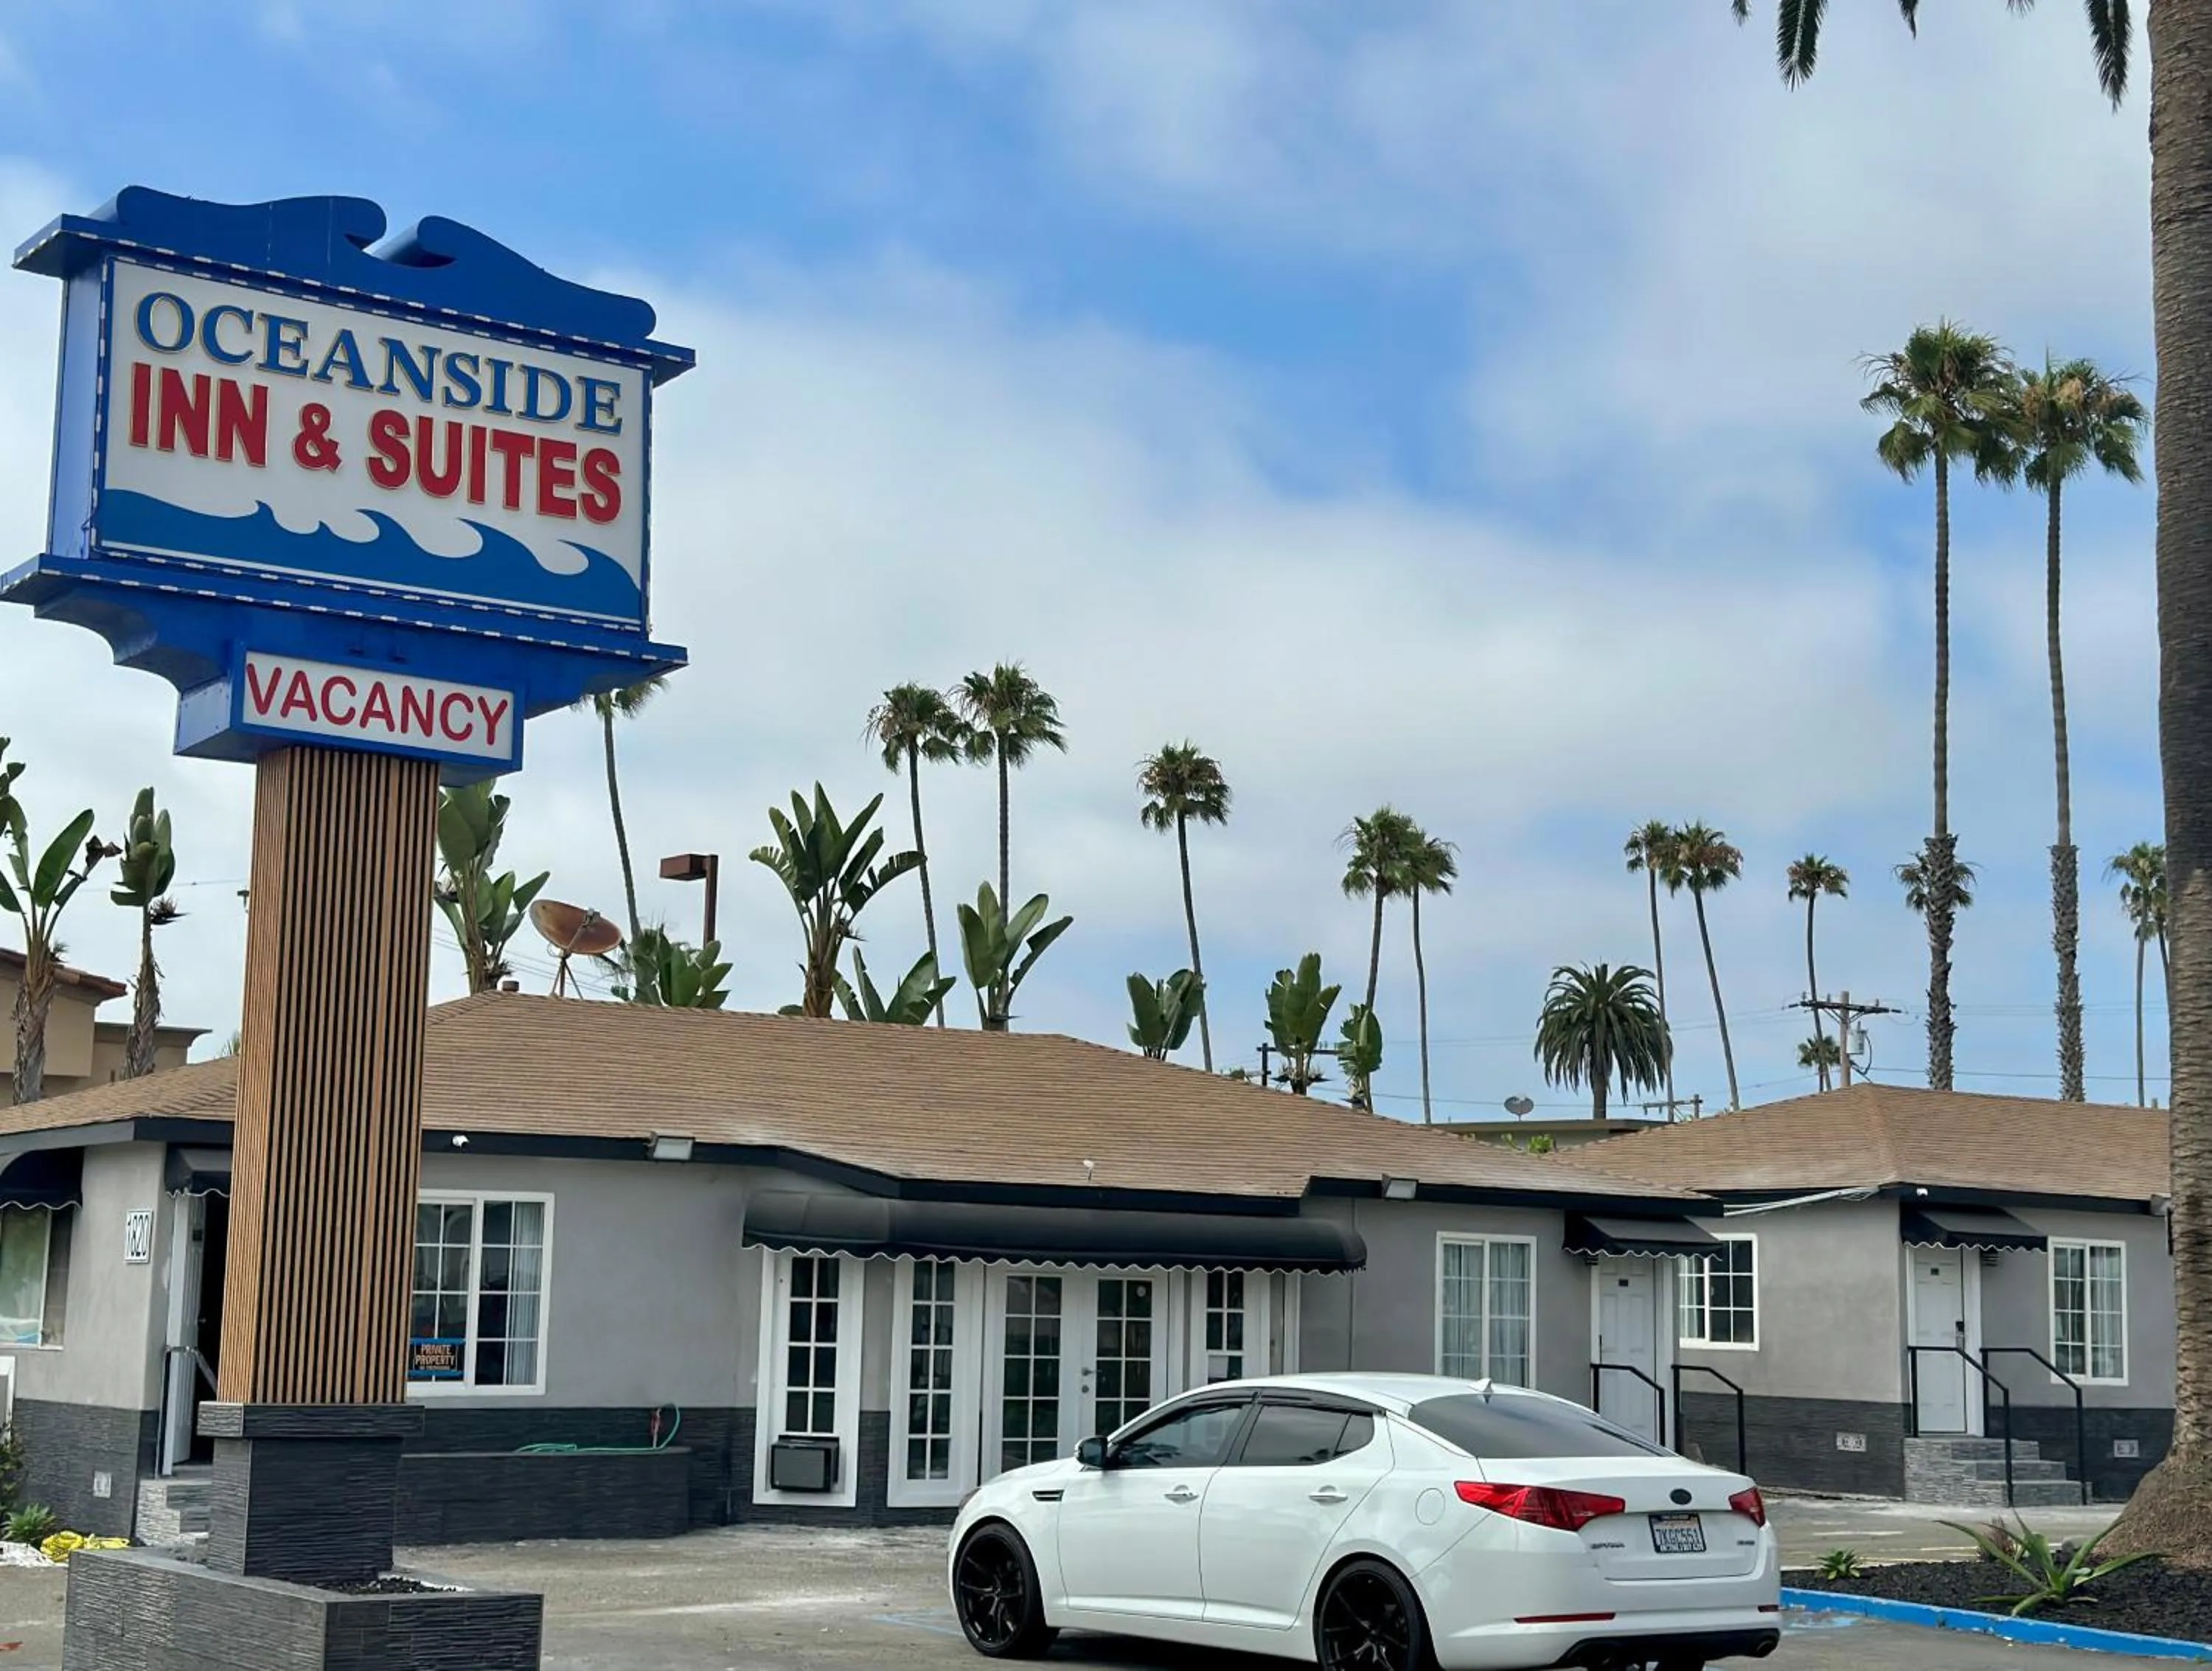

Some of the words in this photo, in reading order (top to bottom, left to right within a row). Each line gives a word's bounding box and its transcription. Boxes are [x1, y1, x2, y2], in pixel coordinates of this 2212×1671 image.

[136, 291, 622, 435] OCEANSIDE
[129, 362, 268, 468] INN
[293, 402, 341, 473] &
[366, 409, 622, 524] SUITES
[247, 663, 508, 746] VACANCY
[415, 1355, 455, 1366] PROPERTY
[421, 1344, 452, 1355] PRIVATE
